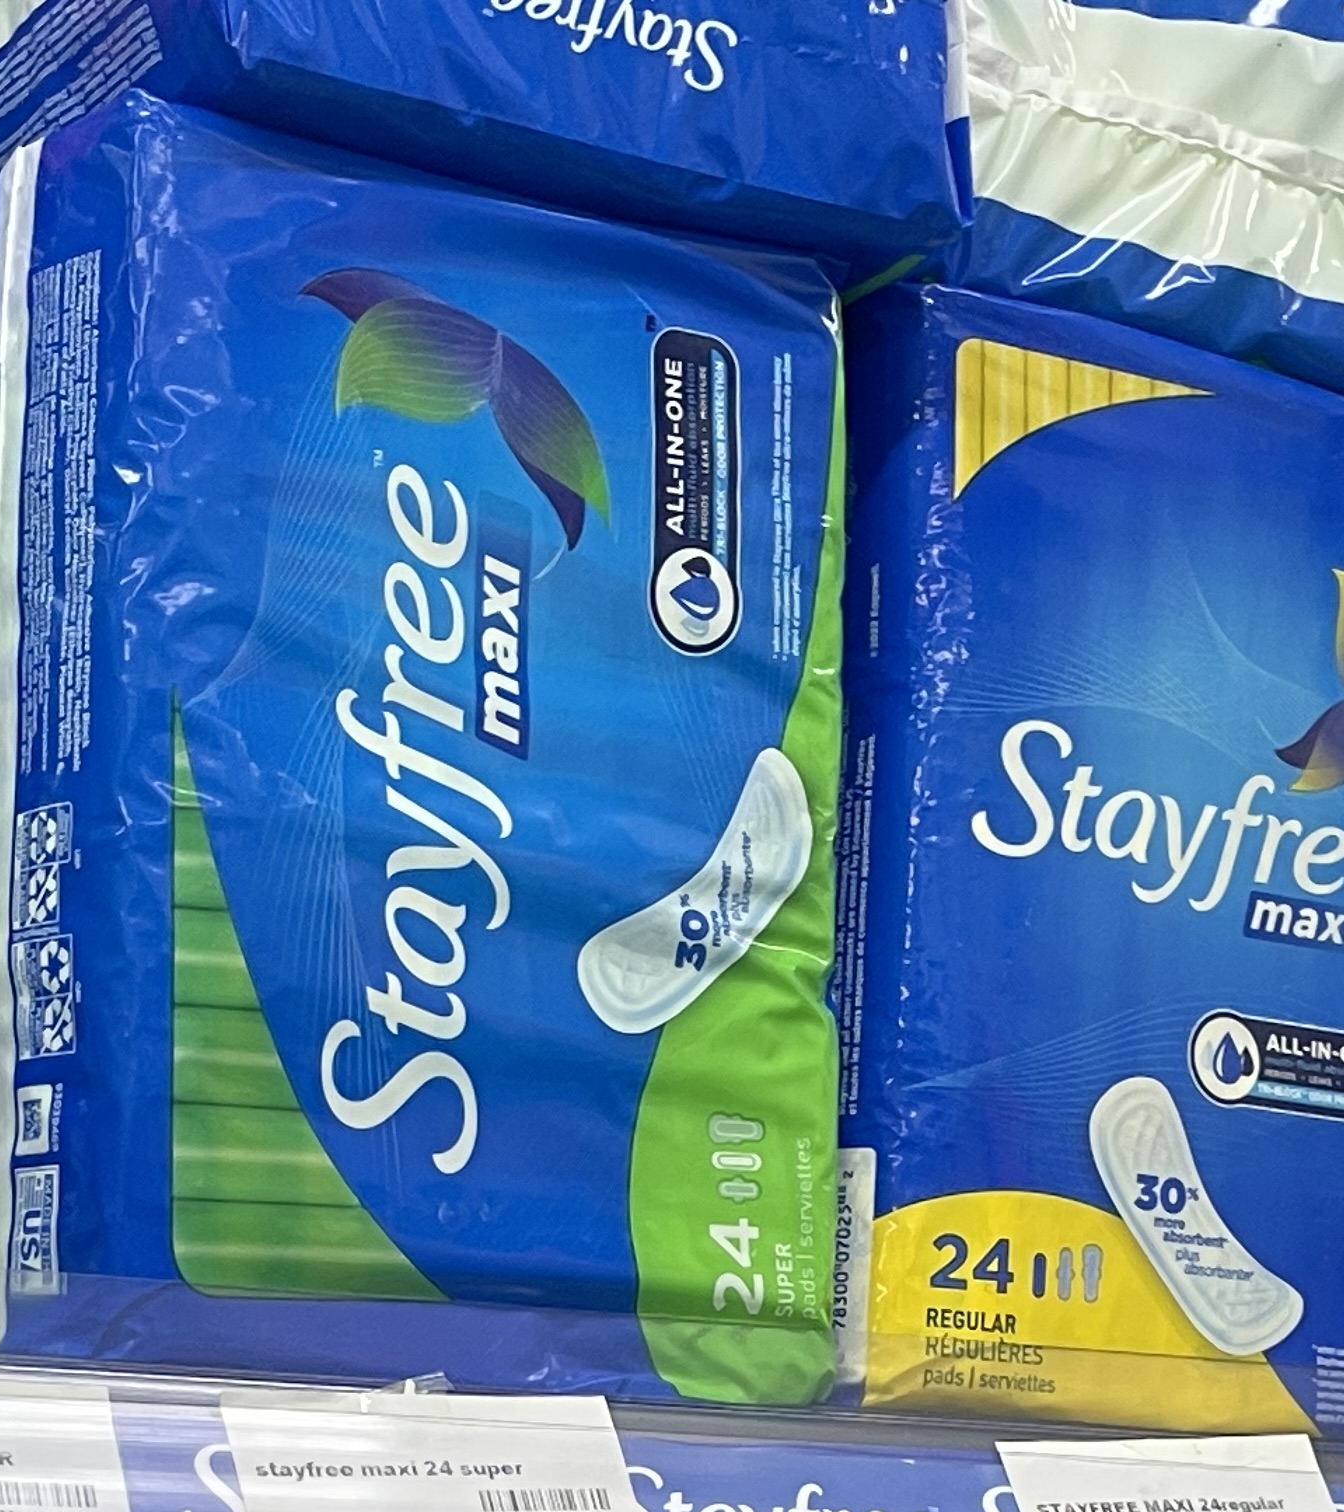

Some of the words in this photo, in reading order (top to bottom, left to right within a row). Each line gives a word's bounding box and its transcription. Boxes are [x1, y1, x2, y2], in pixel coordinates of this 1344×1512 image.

[664, 358, 684, 537] ALL-IN-ONE
[482, 556, 525, 746] maxi
[321, 462, 513, 1175] Stayfree
[675, 894, 709, 971] 30%
[795, 1137, 812, 1248] serviettes
[1134, 1174, 1199, 1214] 30%
[1154, 1216, 1185, 1229] more
[711, 1218, 765, 1316] 24
[775, 1243, 794, 1318] SUPER
[929, 1233, 1014, 1294] 24
[1176, 1247, 1200, 1261] plus
[798, 1268, 817, 1320] pads
[926, 1307, 1016, 1334] REGULAR
[925, 1333, 1043, 1365] RÉGULIÈRES
[922, 1366, 964, 1388] pads
[978, 1373, 1056, 1393] serviettes
[256, 1462, 354, 1480] stayfree
[361, 1462, 418, 1477] maxi
[422, 1461, 453, 1477] 24
[460, 1462, 523, 1478] super
